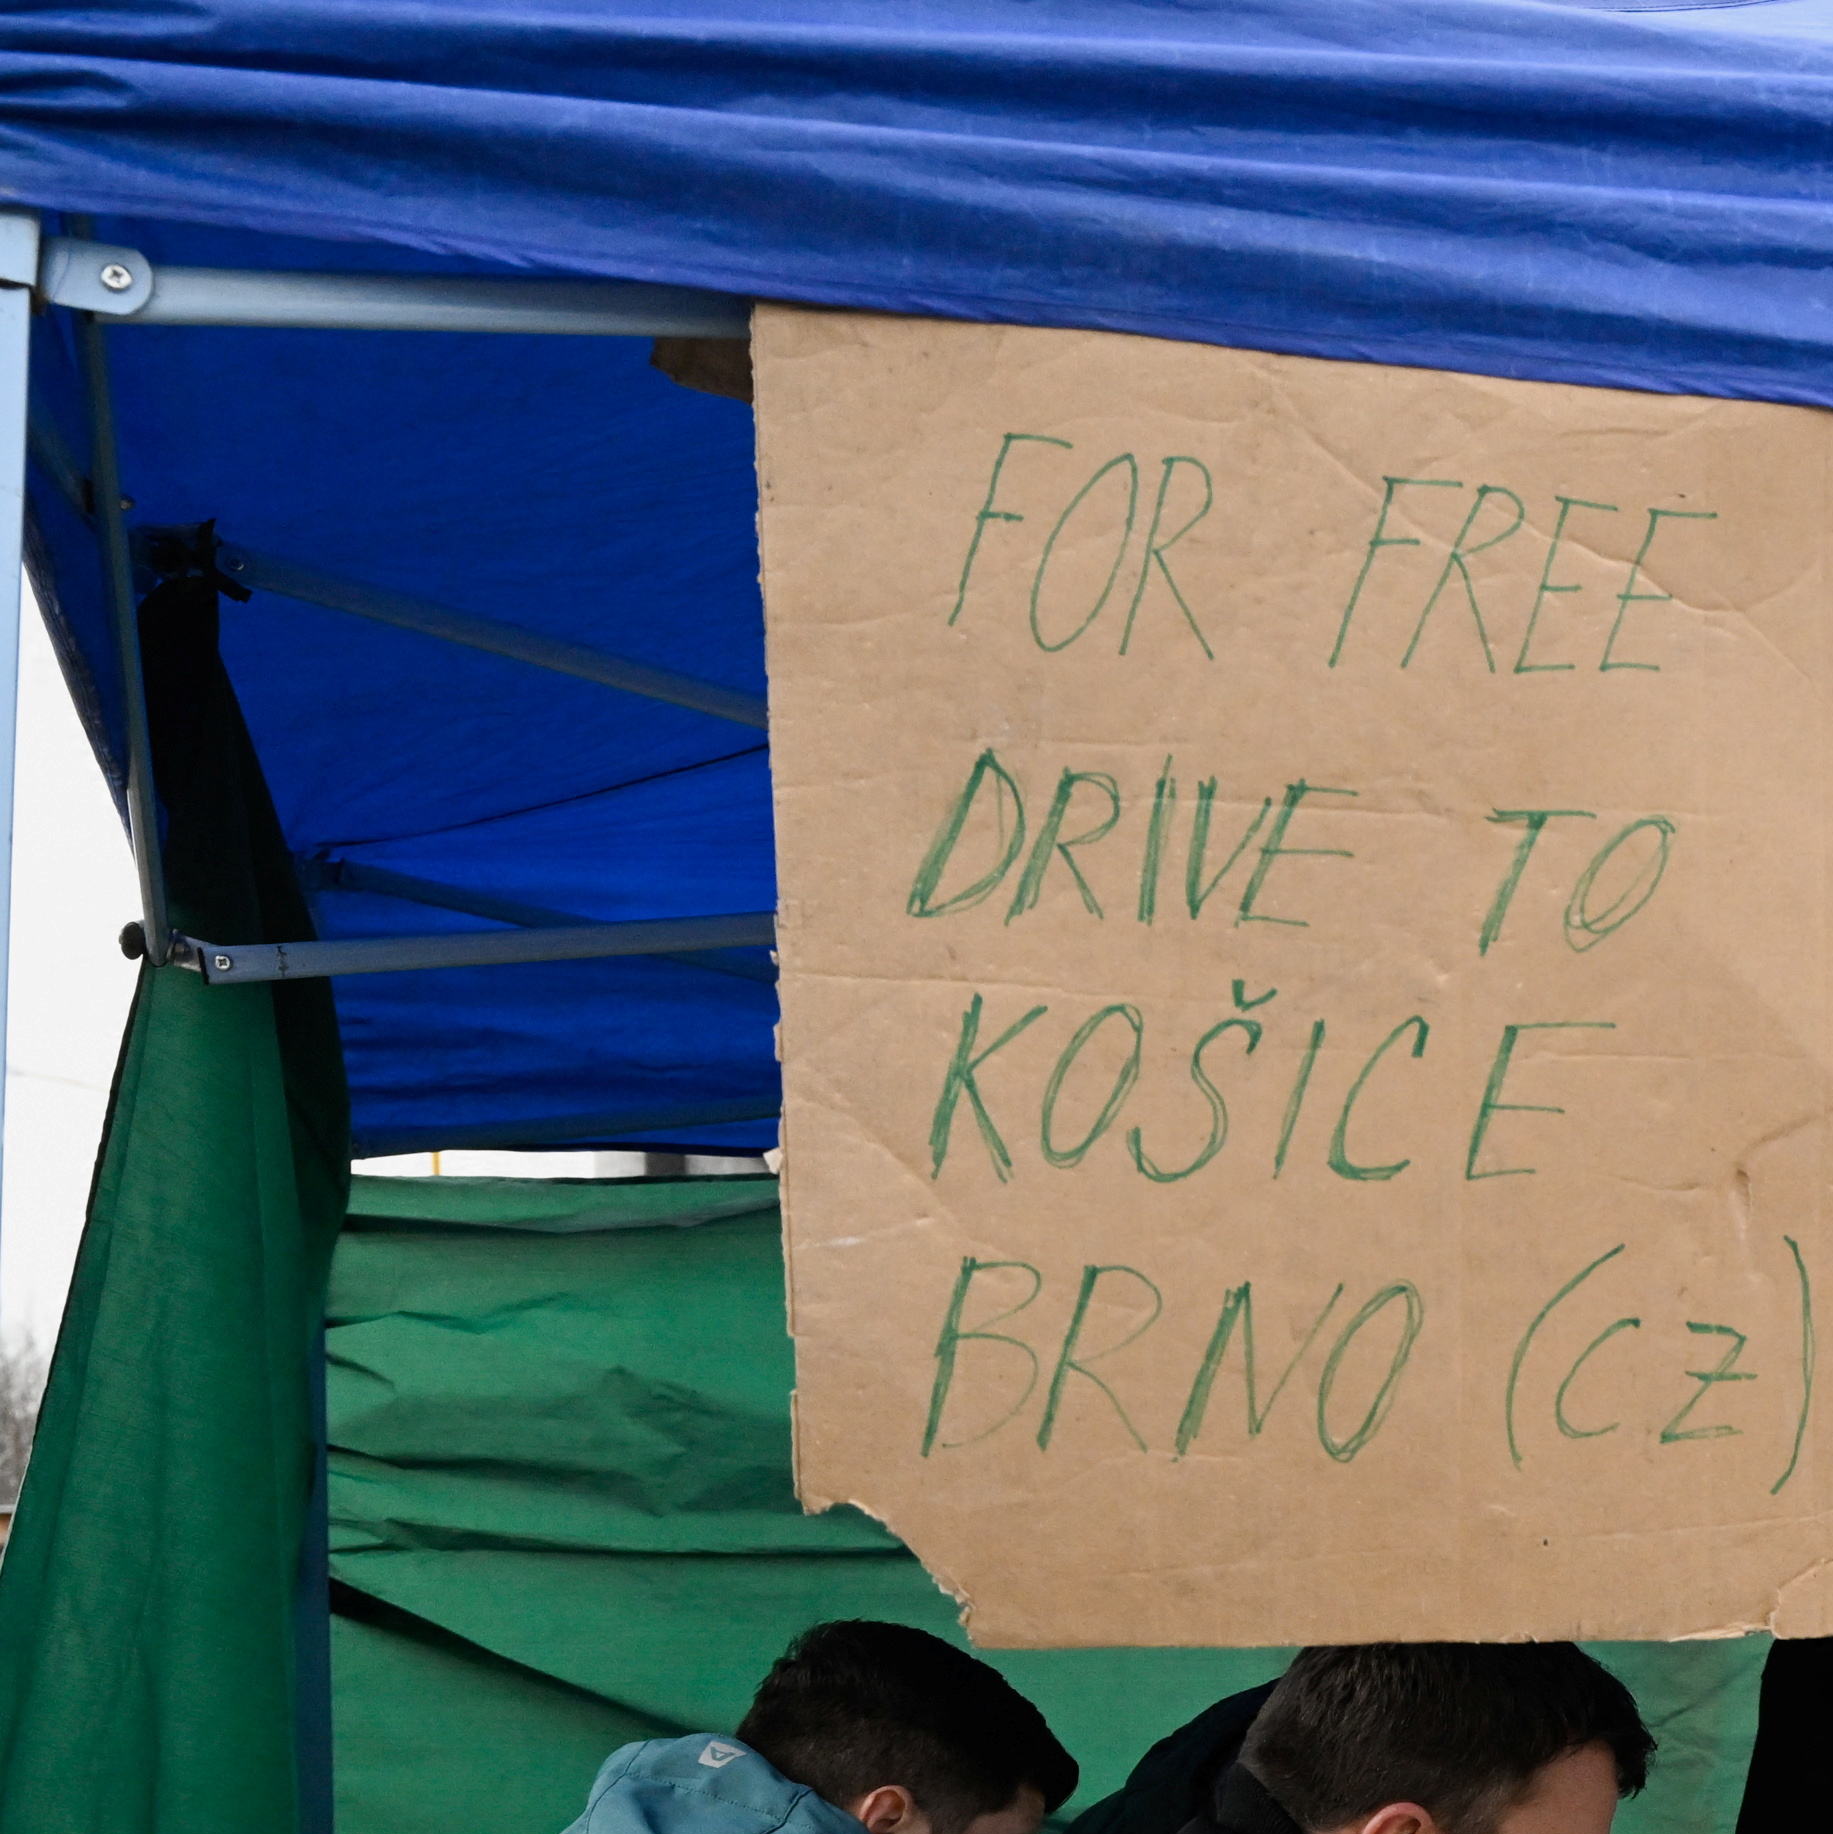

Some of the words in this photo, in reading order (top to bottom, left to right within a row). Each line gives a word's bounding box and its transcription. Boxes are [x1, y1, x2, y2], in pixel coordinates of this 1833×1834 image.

[948, 433, 1214, 660] FOR
[1330, 474, 1718, 676] FREE
[907, 746, 1359, 929] DRIVE
[1477, 806, 1676, 955] TO
[929, 978, 1617, 1182] KOŠICE
[921, 1254, 1425, 1462] BRNO
